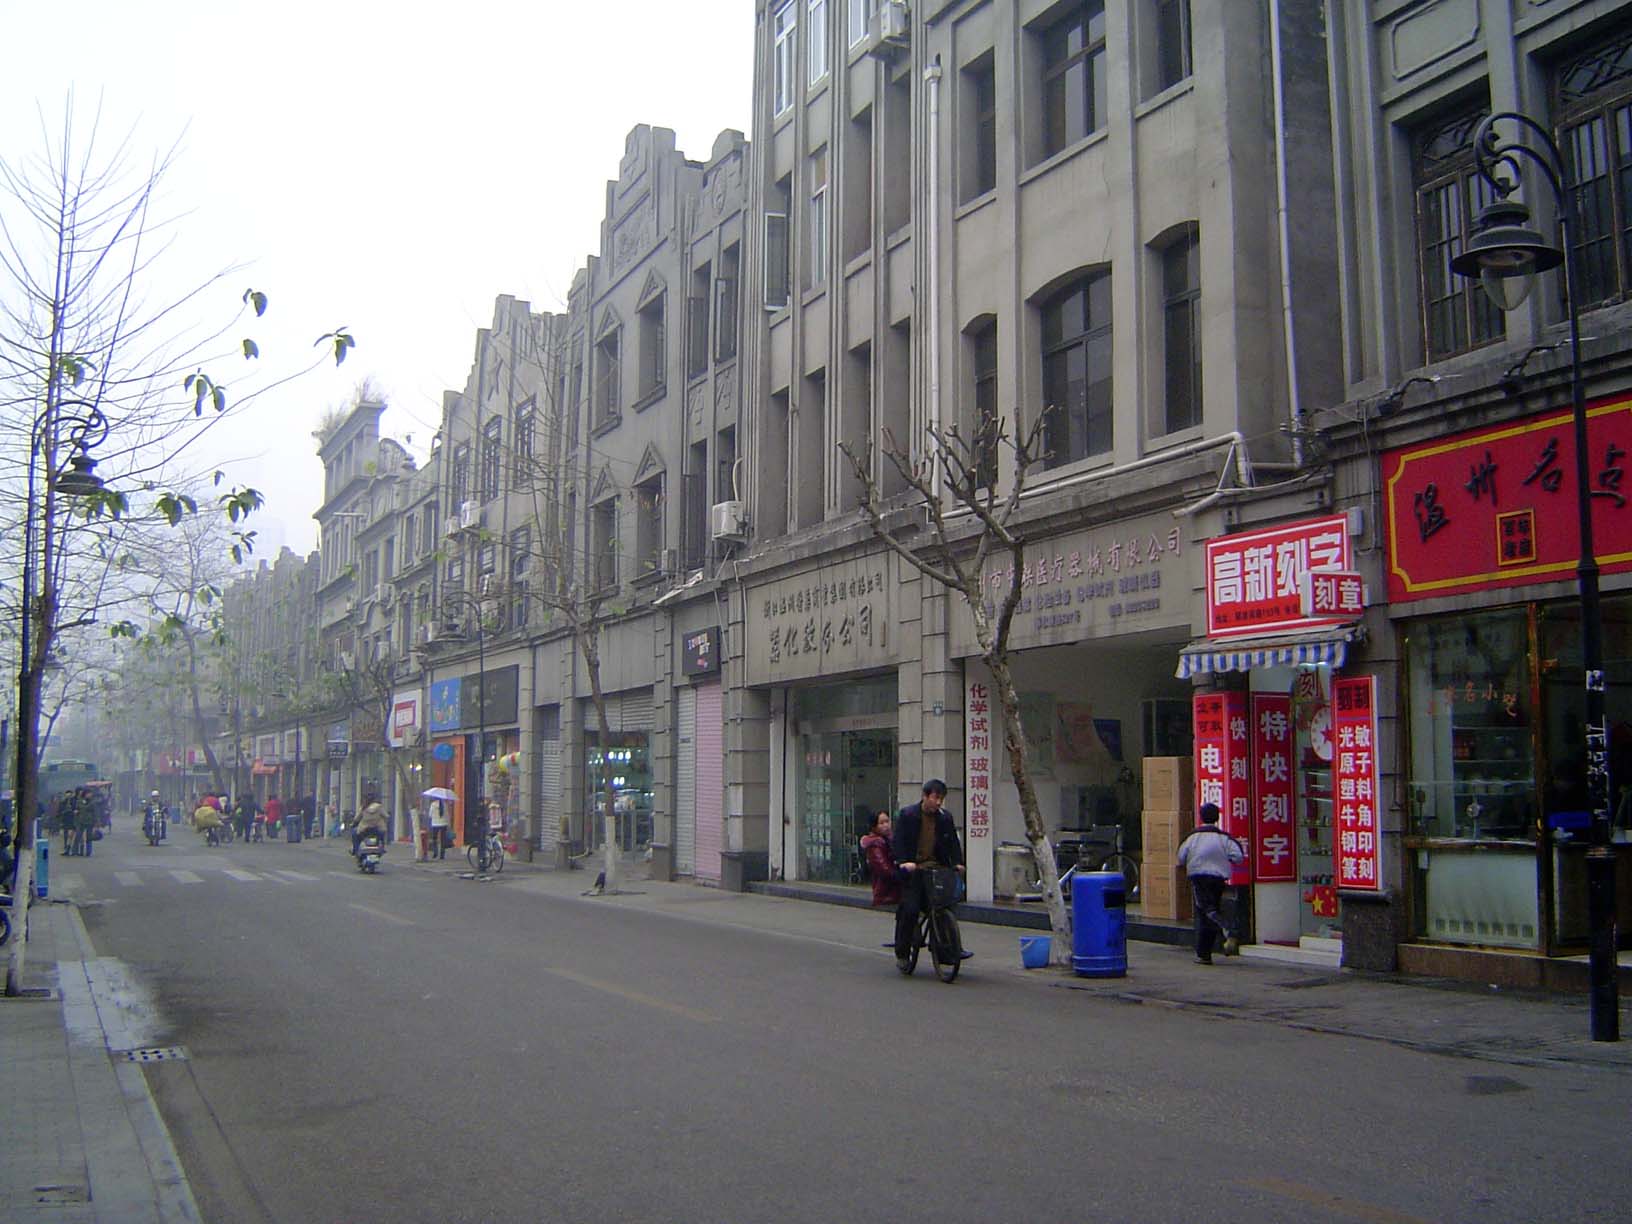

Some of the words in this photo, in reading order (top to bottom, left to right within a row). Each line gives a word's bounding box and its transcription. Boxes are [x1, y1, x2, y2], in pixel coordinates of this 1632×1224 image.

[1213, 532, 1343, 606] 高新刻字
[1314, 578, 1361, 611] 刻章
[970, 683, 988, 750] 化学试剂
[1339, 724, 1371, 748] 光敏
[1340, 752, 1371, 774] 原子
[970, 756, 989, 826] 玻璃仪器
[1200, 743, 1223, 829] 电脑
[1260, 710, 1289, 865] 特快刻字
[1340, 778, 1372, 800] 塑料
[1341, 804, 1372, 827] 牛角
[970, 828, 989, 838] 527
[1341, 830, 1373, 854] 钢印
[1342, 857, 1374, 880] 篆刻
